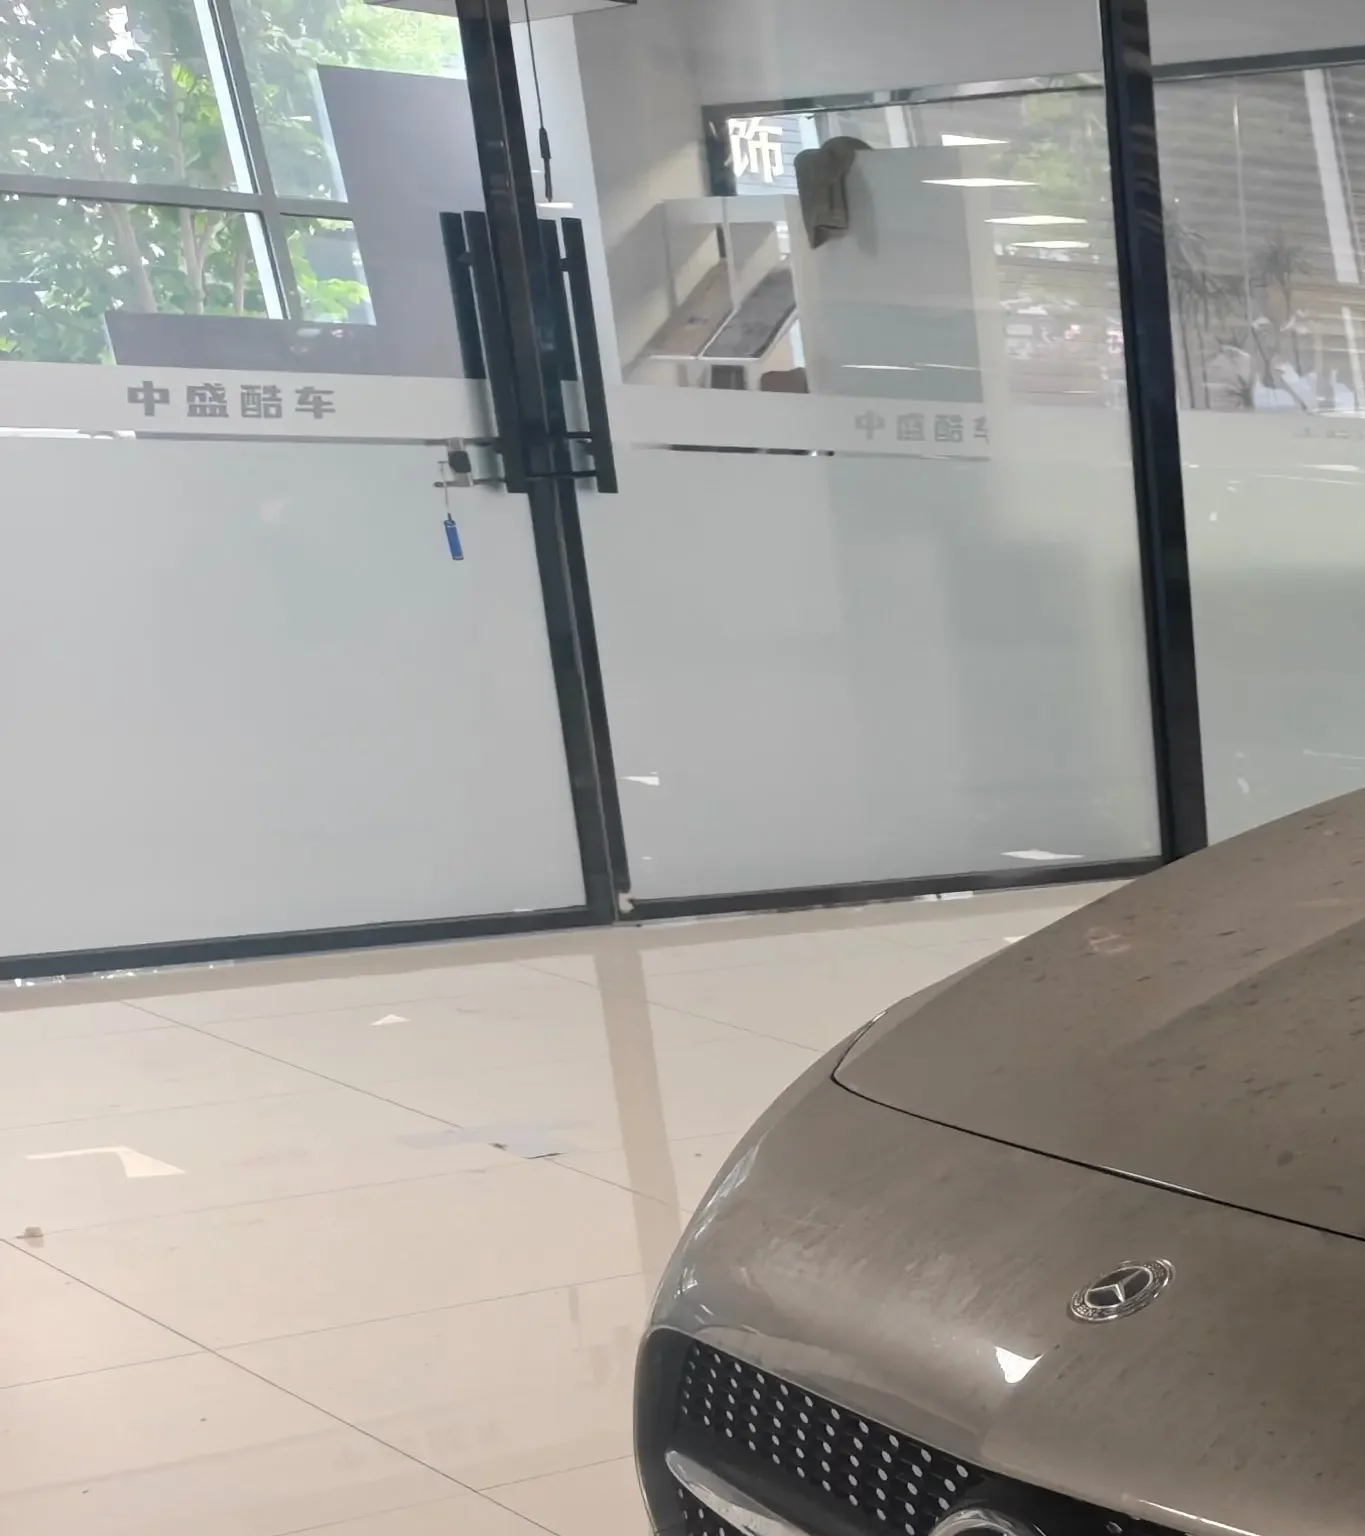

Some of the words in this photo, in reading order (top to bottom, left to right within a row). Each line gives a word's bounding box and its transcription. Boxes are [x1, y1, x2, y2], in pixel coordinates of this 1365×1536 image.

[725, 117, 784, 183] 饰
[127, 380, 336, 420] 中盛酷车
